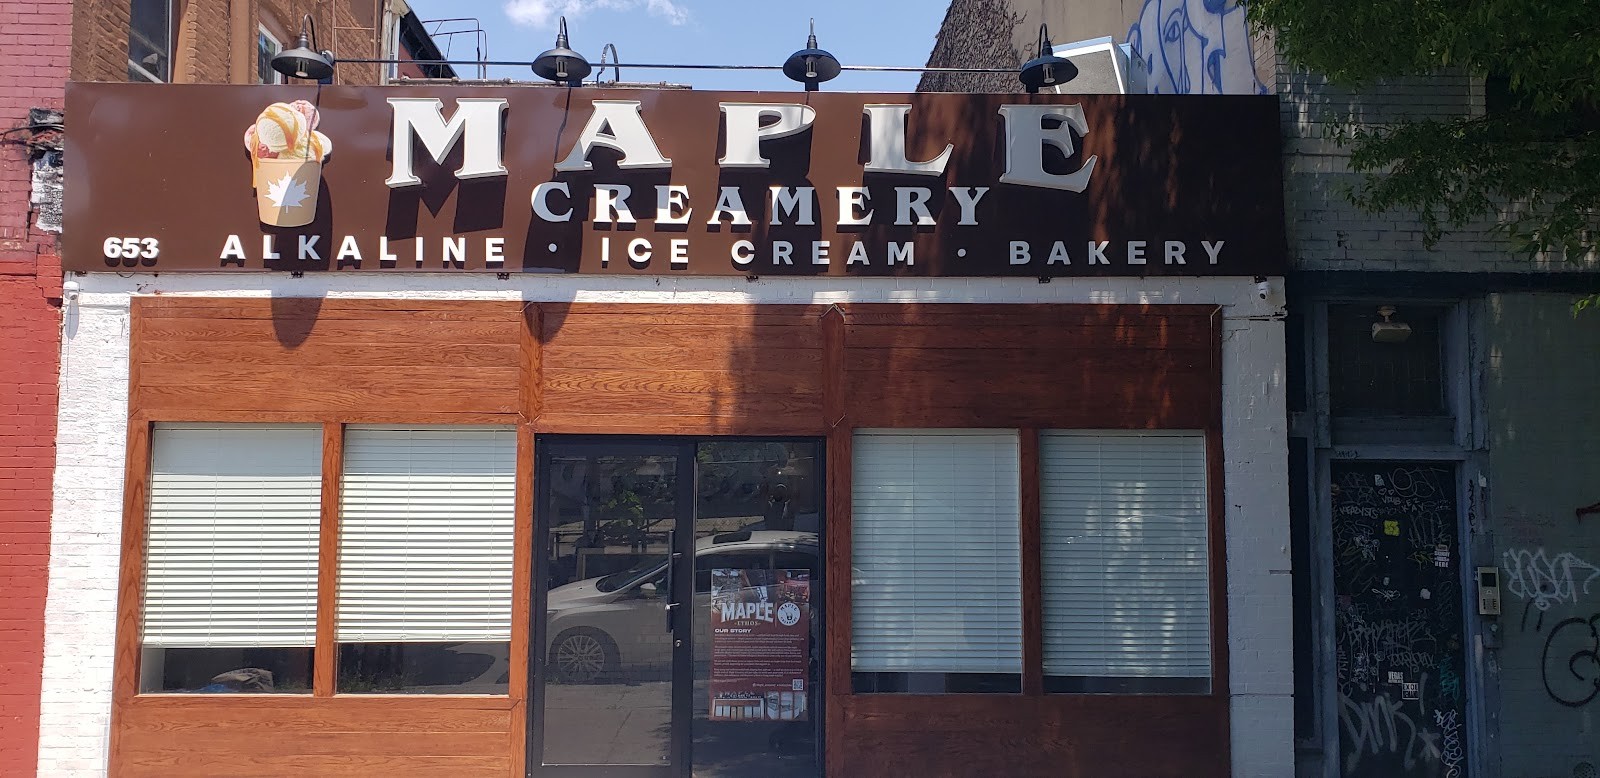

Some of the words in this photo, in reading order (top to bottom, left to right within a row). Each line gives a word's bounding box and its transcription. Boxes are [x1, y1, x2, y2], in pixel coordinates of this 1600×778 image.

[385, 96, 1098, 193] MAPLE
[531, 181, 990, 228] CREAMERY
[103, 236, 160, 264] 653
[220, 233, 506, 263] ALKALINE
[601, 236, 690, 266] ICE
[731, 239, 916, 266] CREAM
[1009, 239, 1227, 266] BAKERY
[720, 602, 774, 623] MAPLE
